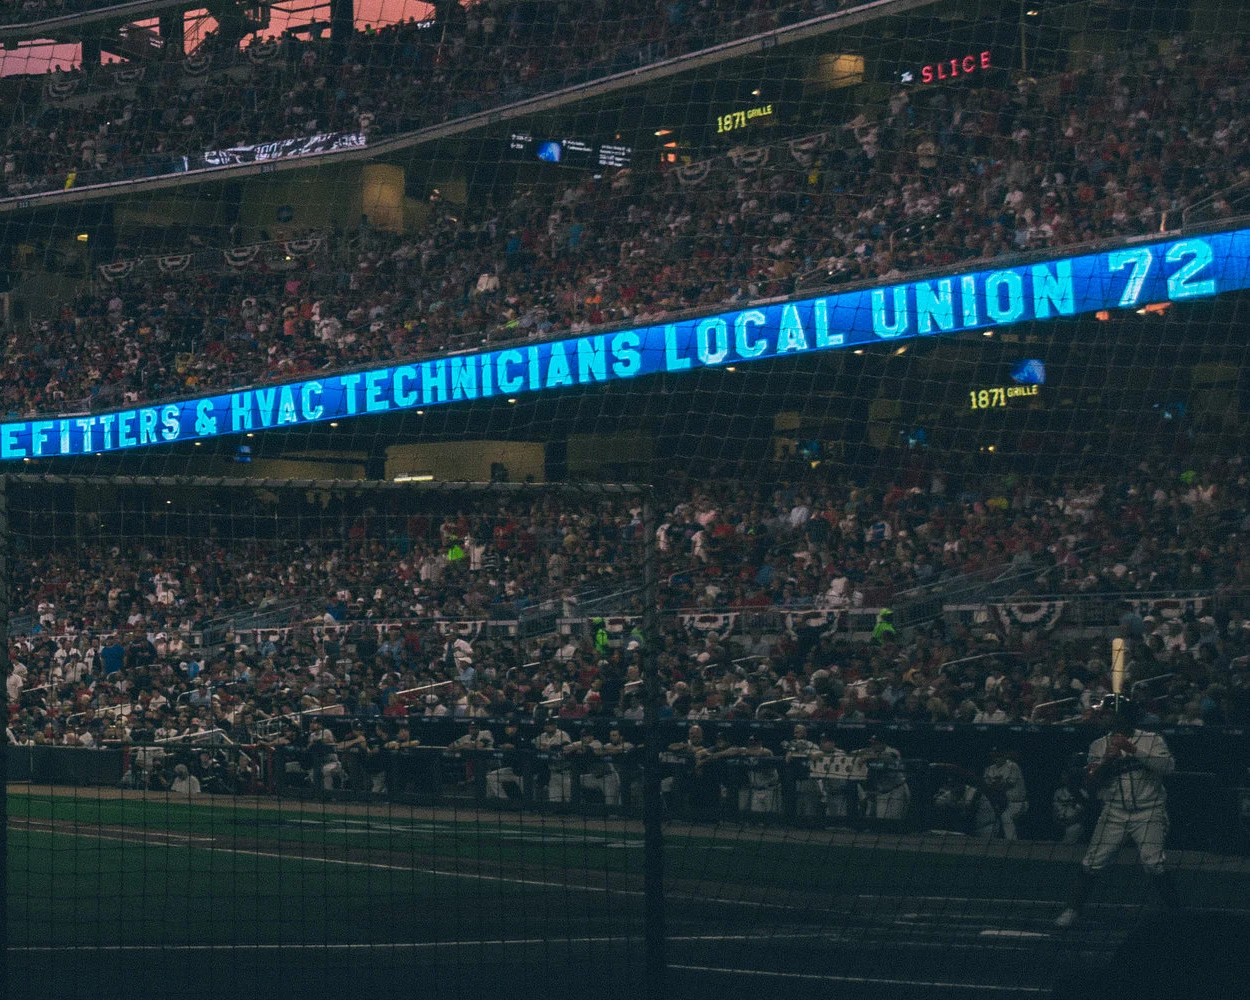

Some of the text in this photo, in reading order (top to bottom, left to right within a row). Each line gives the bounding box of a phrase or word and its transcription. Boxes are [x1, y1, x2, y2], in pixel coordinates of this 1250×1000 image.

[921, 51, 991, 83] SLICE
[717, 110, 747, 133] 1871
[195, 398, 216, 436] &
[232, 381, 324, 432] HVAC
[341, 331, 642, 414] TECHNICIANS
[664, 299, 844, 371] LOCAL
[872, 259, 1075, 338] UNION
[1108, 238, 1216, 307] 72
[970, 384, 1038, 409] 1871 GRILLE
